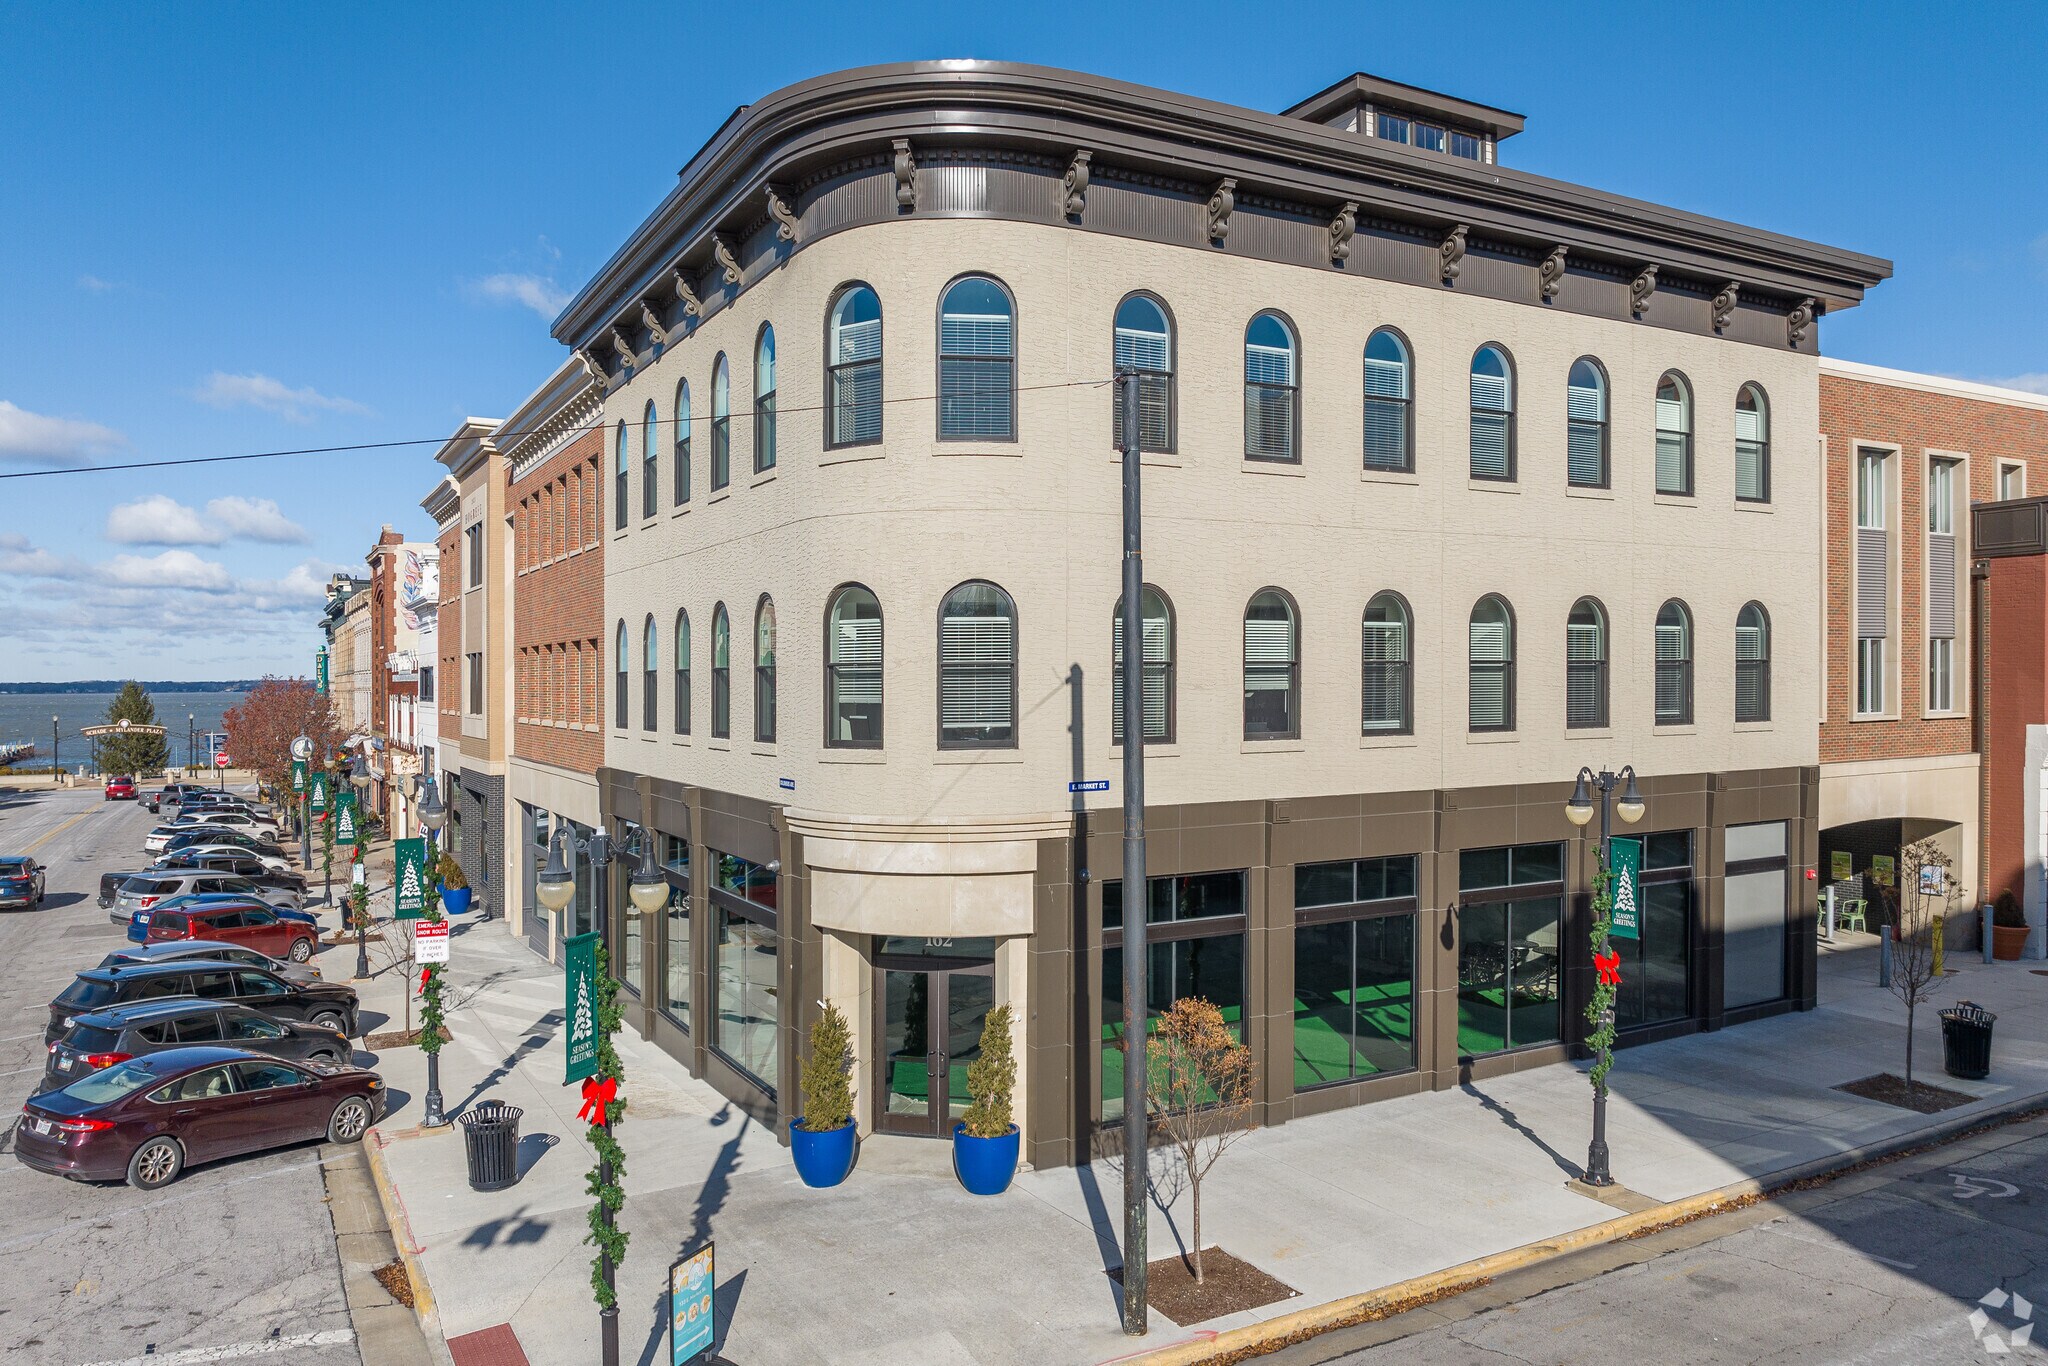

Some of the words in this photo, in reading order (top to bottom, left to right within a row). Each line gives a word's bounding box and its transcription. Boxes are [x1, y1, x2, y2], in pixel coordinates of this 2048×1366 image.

[1078, 782, 1099, 790] MARKET
[1615, 912, 1635, 920] SEASON'S
[1613, 918, 1636, 928] GREETINGS
[572, 1040, 593, 1055] SEASON'S
[570, 1048, 595, 1065] GREETINGS
